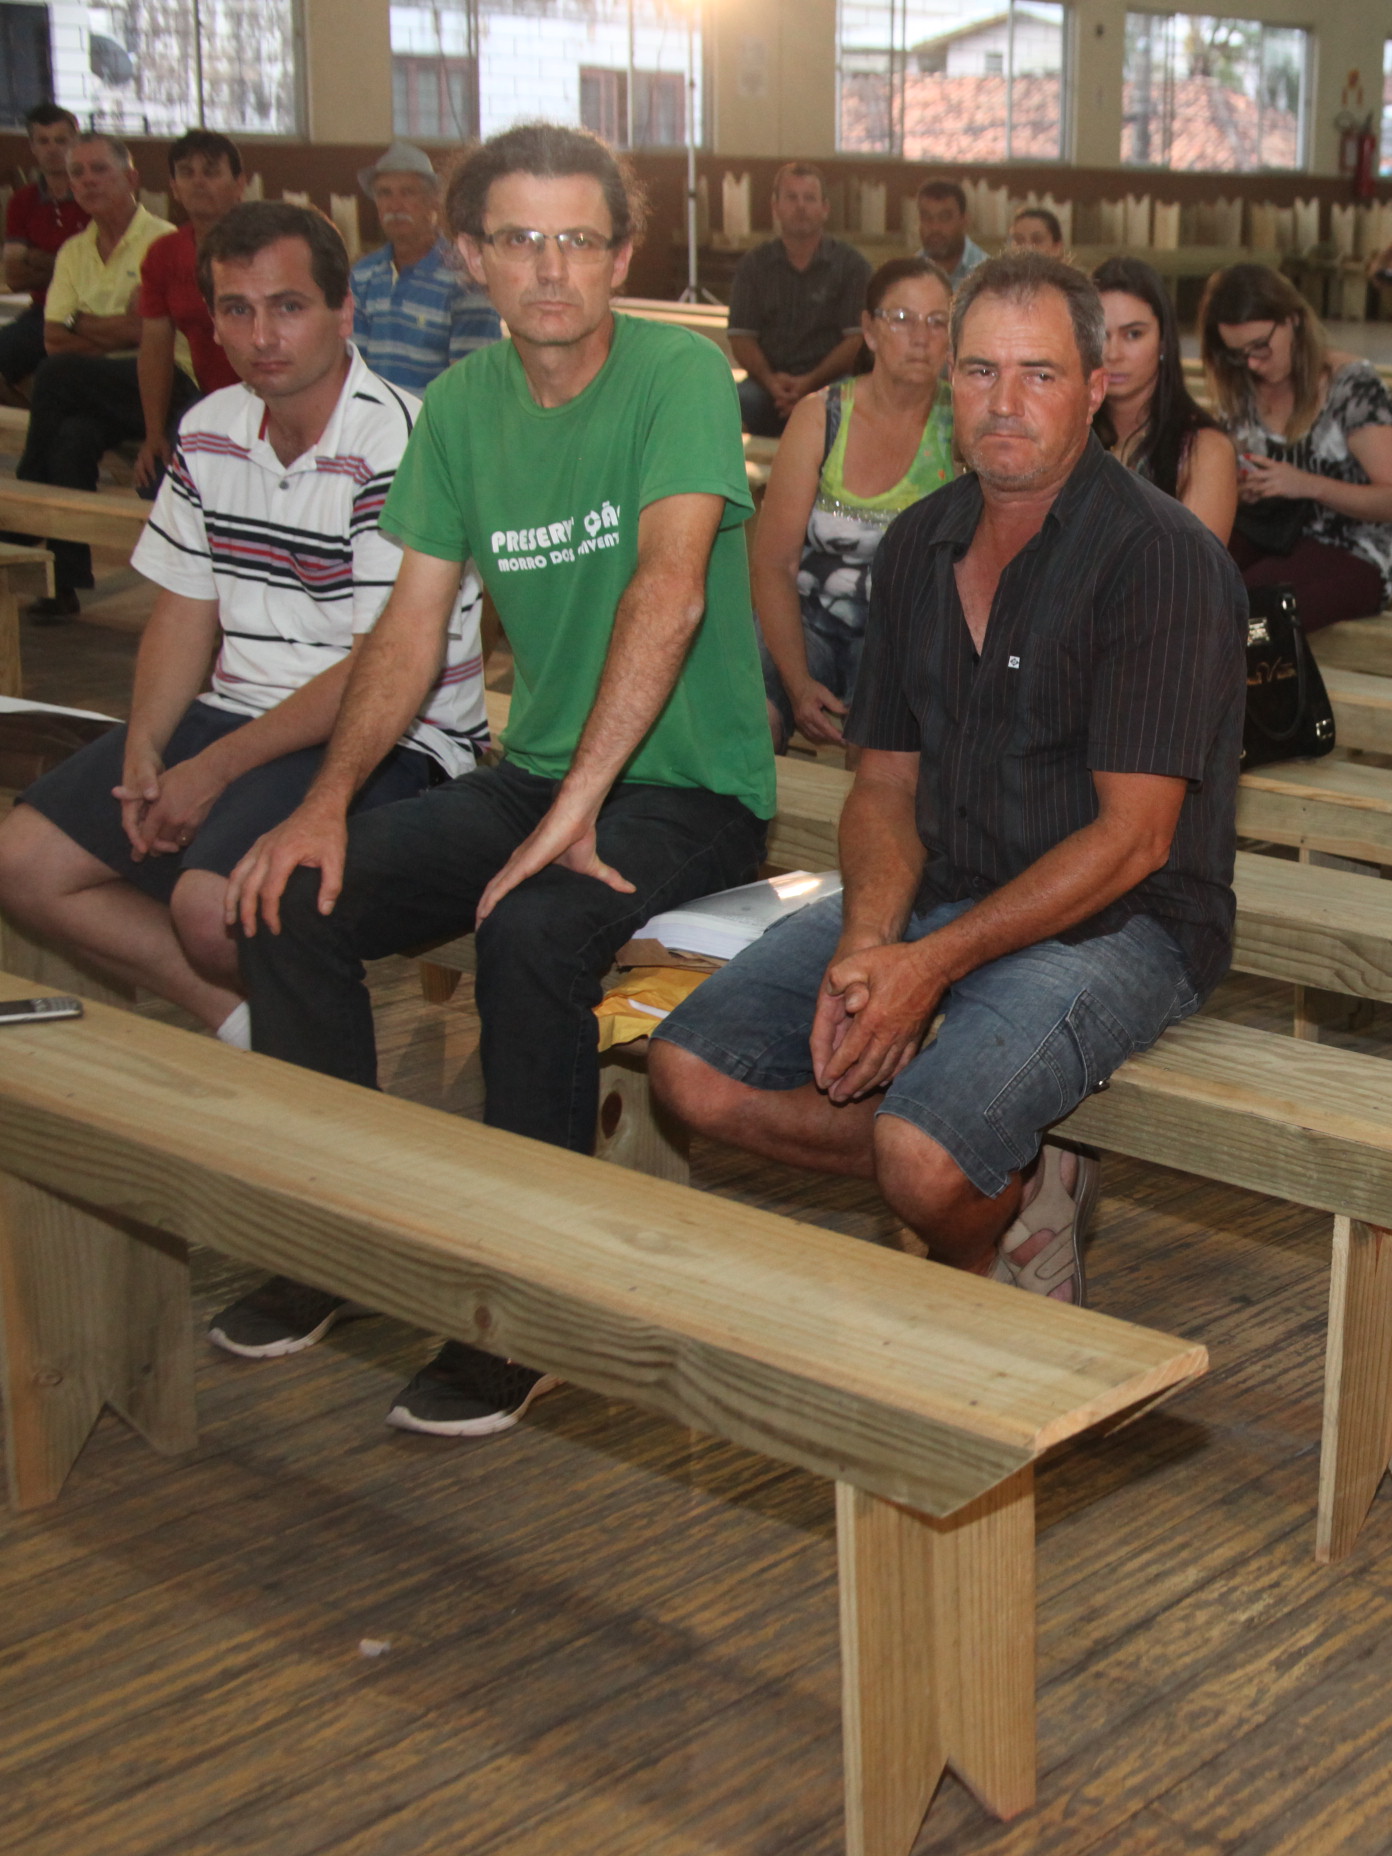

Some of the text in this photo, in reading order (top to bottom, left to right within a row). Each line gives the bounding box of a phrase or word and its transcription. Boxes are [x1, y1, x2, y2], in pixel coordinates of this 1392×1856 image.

[491, 500, 620, 553] PRESERVÇÃ
[498, 554, 547, 572] MORRO
[549, 548, 575, 564] DOS
